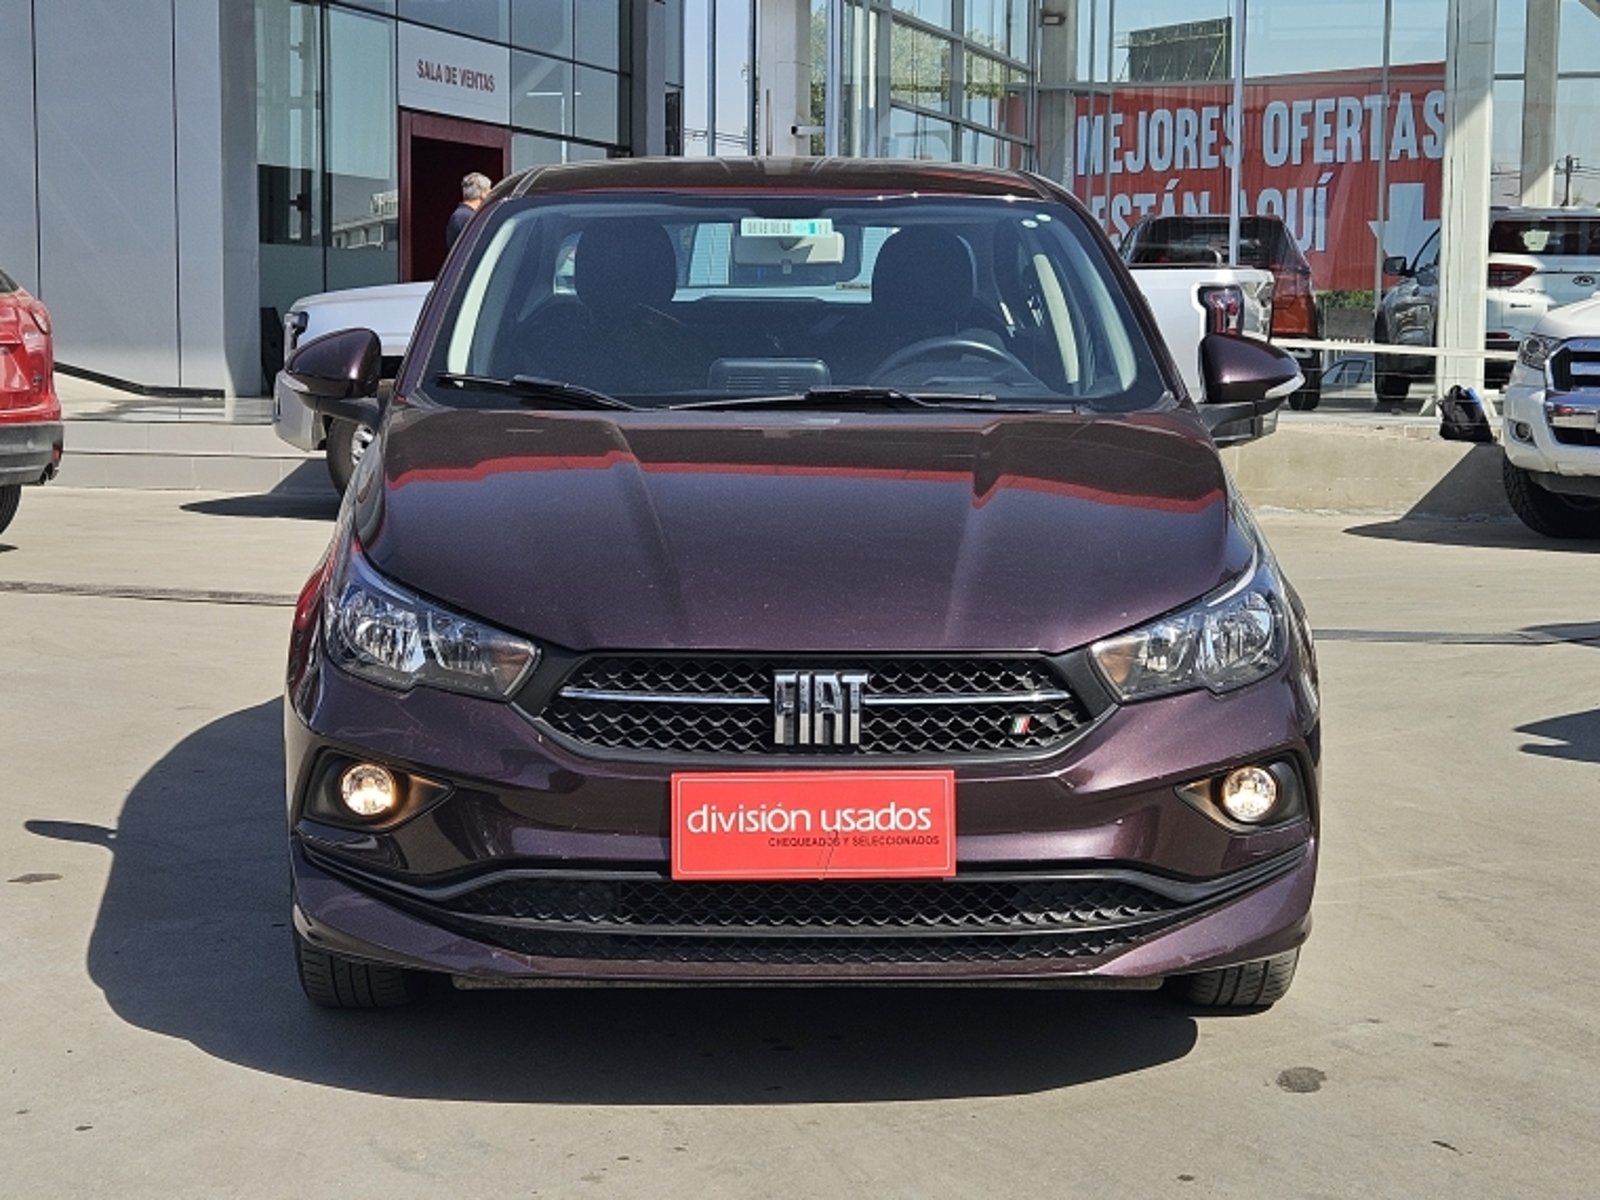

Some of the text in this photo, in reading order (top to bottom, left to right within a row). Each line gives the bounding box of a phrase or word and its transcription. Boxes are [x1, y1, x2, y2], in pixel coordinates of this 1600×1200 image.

[416, 58, 496, 93] SALA DE VENTAS
[1076, 90, 1446, 176] MEJORES OFERTAS
[1239, 172, 1334, 256] UÍ
[774, 671, 869, 745] FIAT
[687, 802, 932, 833] división usados
[768, 834, 940, 848] CHEQUEADOS Y SELECCIONADOS
